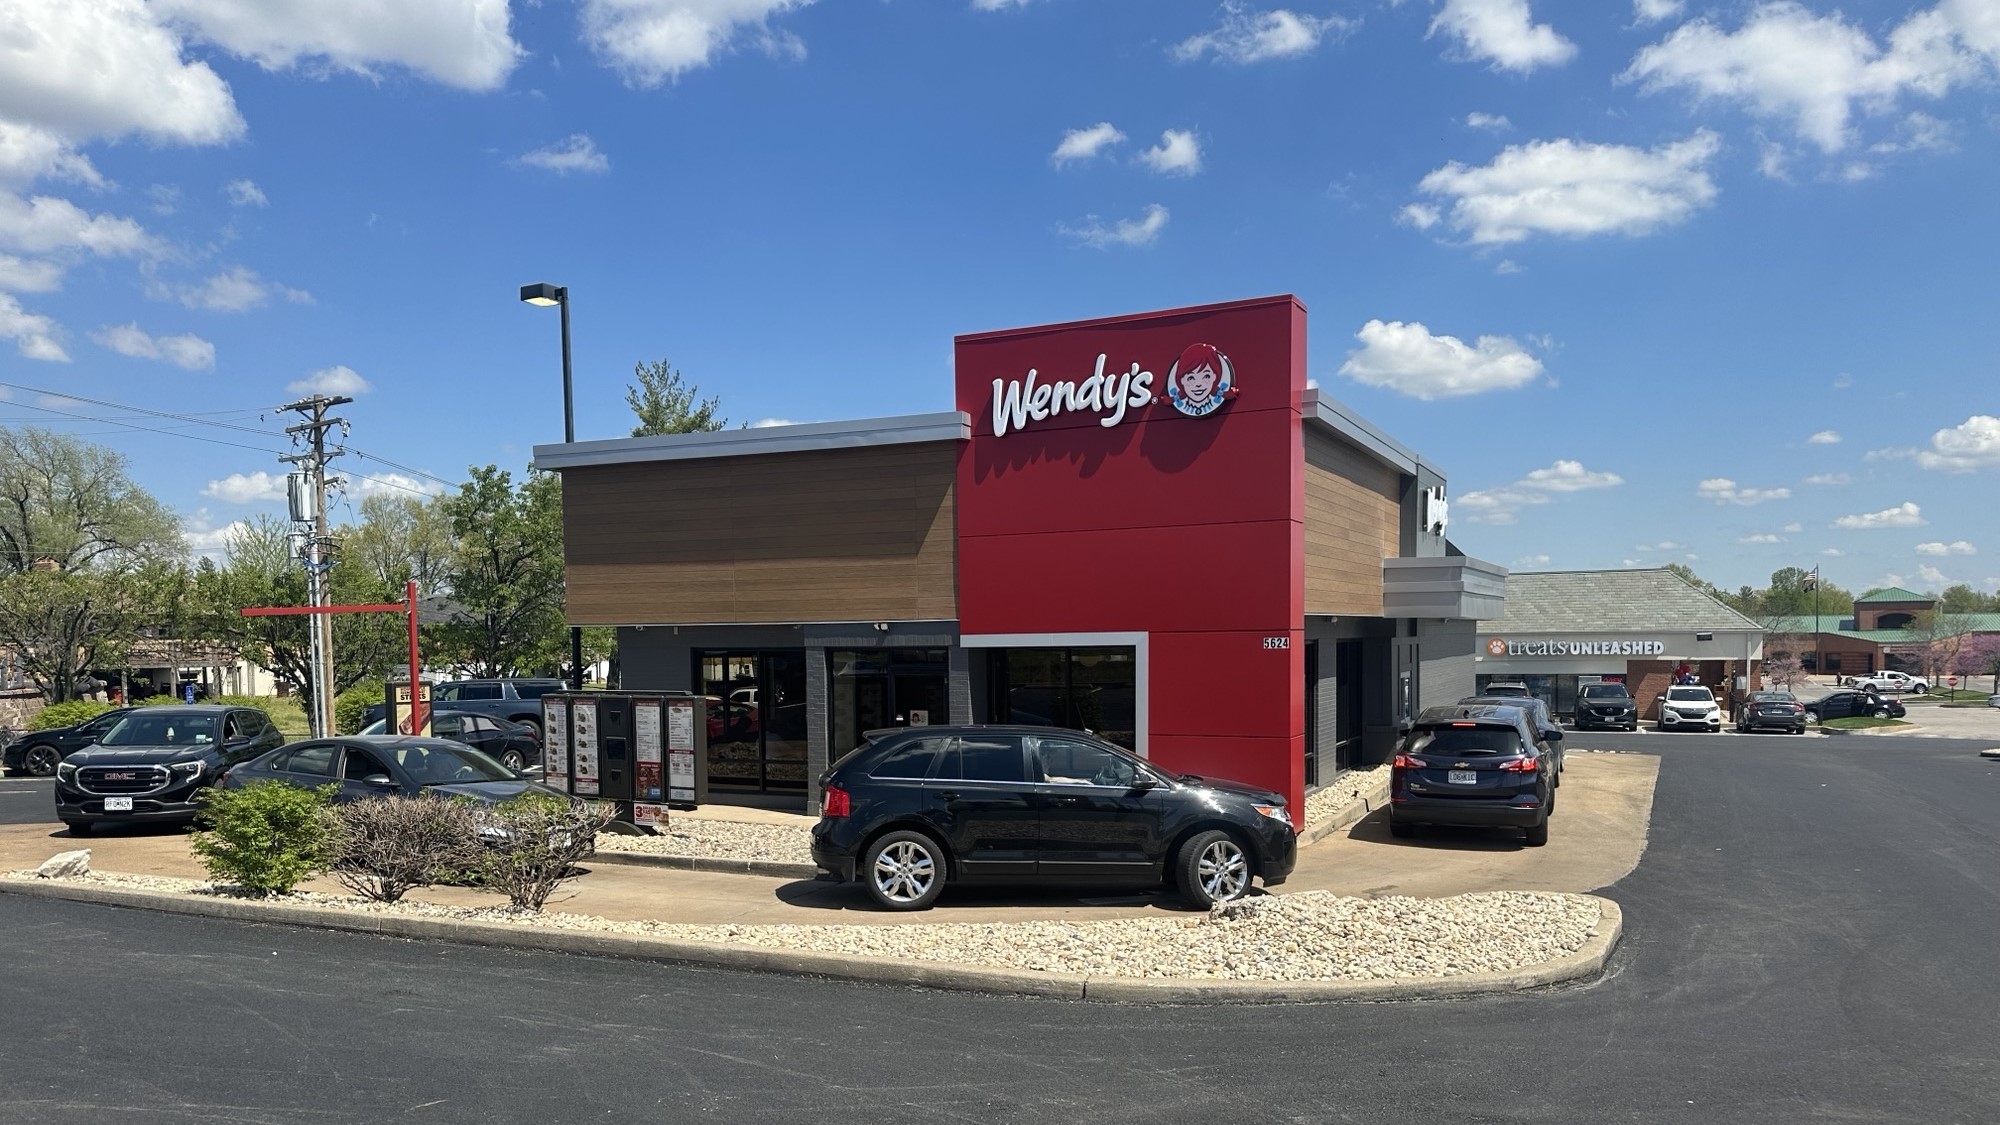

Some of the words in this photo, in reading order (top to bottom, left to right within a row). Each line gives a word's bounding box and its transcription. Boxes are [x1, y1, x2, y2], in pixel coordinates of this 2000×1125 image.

[992, 353, 1154, 437] Wendy's
[1264, 638, 1288, 648] 5624
[1508, 639, 1567, 656] treats
[1570, 641, 1665, 655] UNLEASHED
